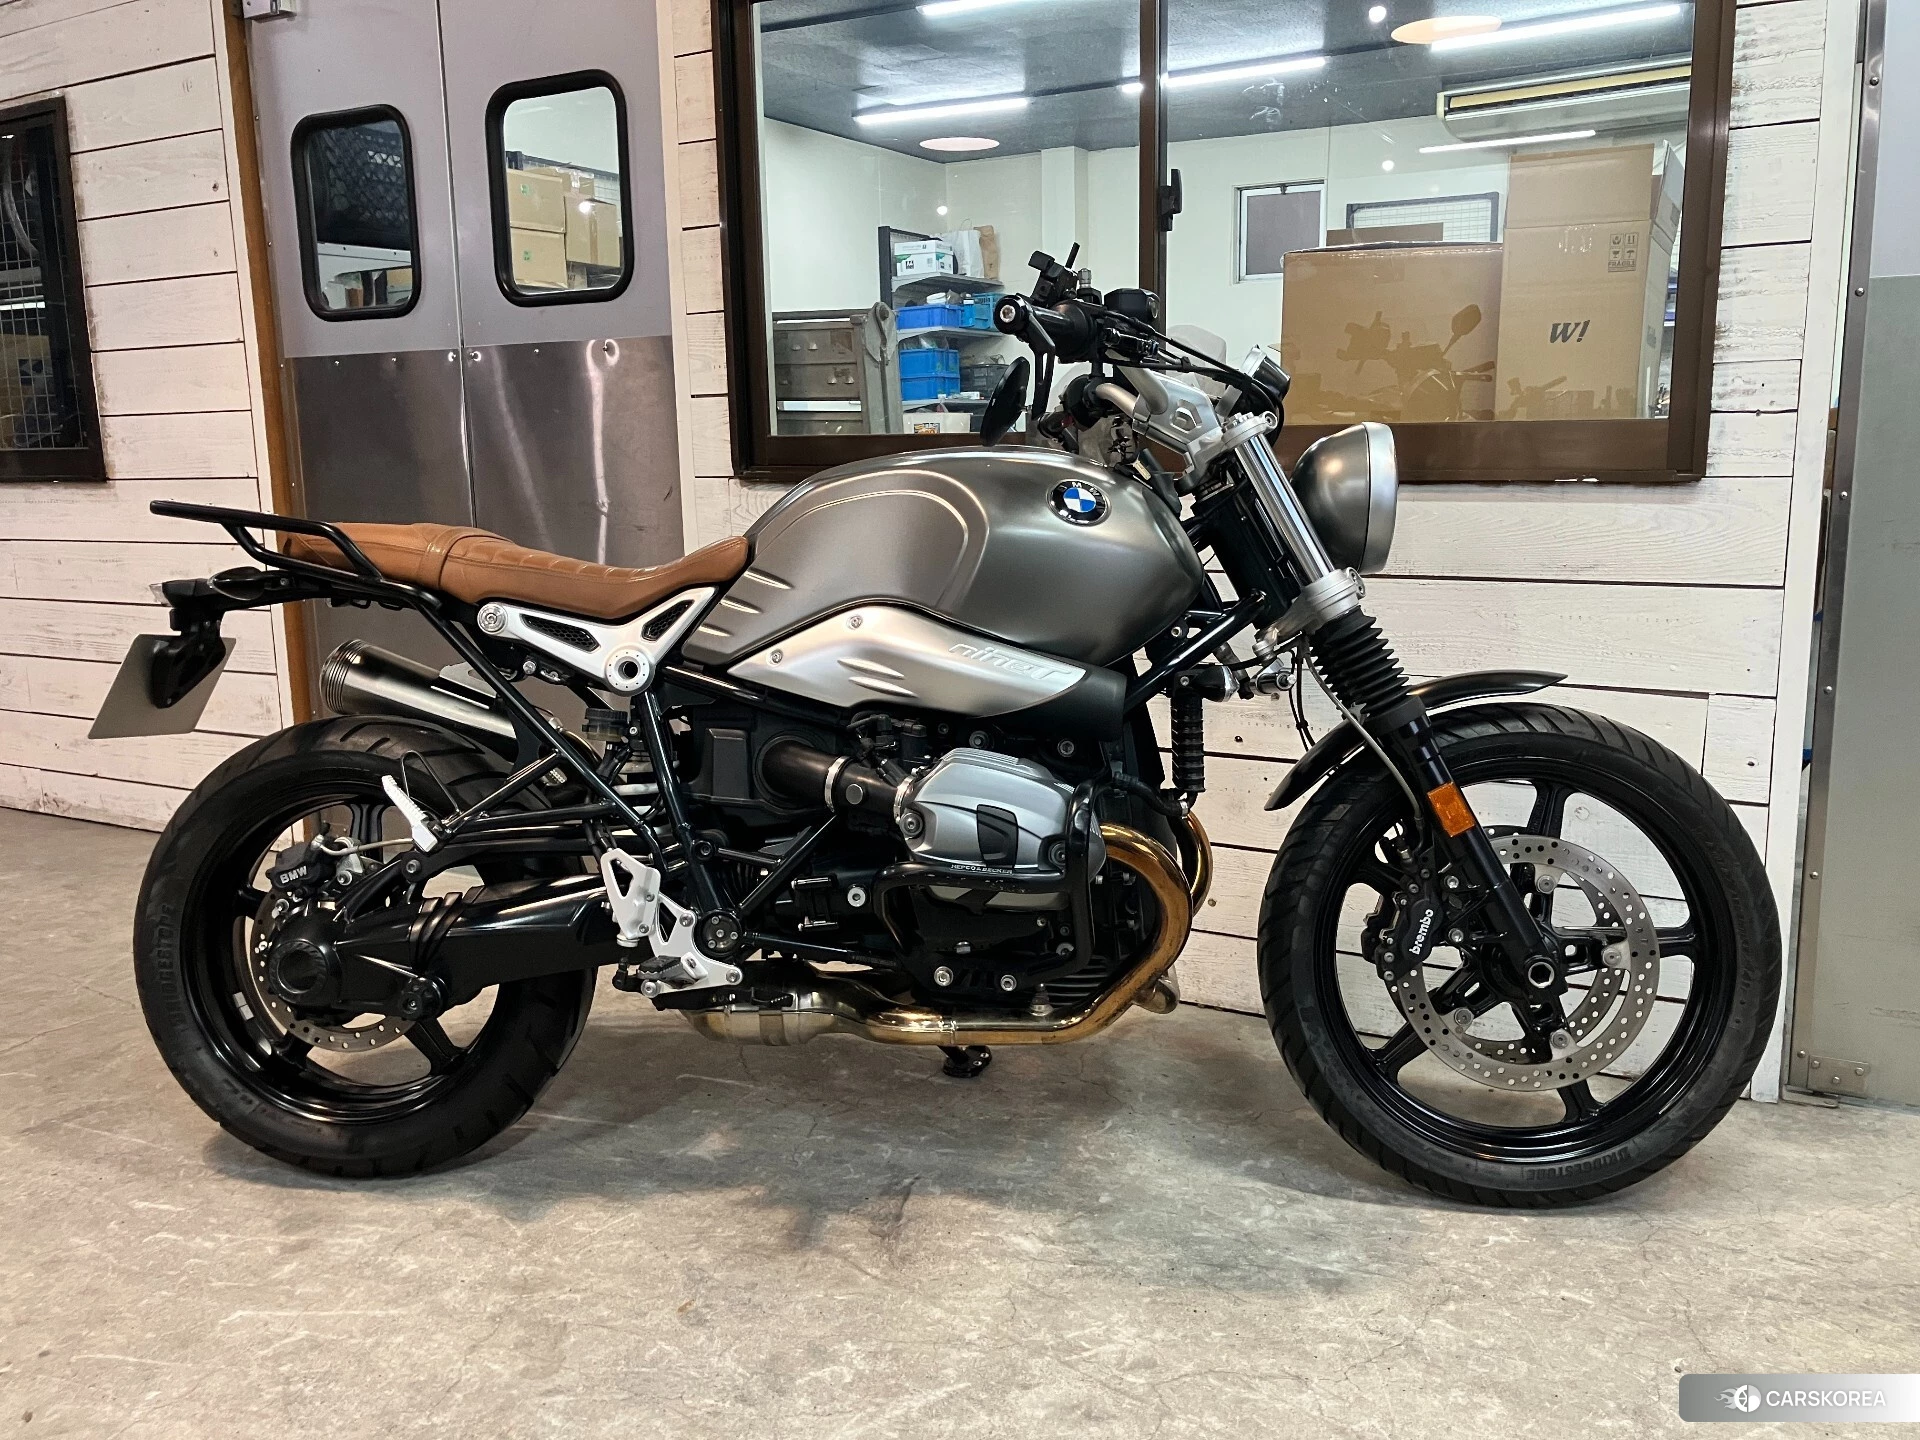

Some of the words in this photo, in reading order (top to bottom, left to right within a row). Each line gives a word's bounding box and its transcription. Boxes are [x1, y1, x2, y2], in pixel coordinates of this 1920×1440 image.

[1550, 320, 1590, 343] W!
[280, 865, 308, 884] BMW
[1409, 909, 1434, 955] brembo
